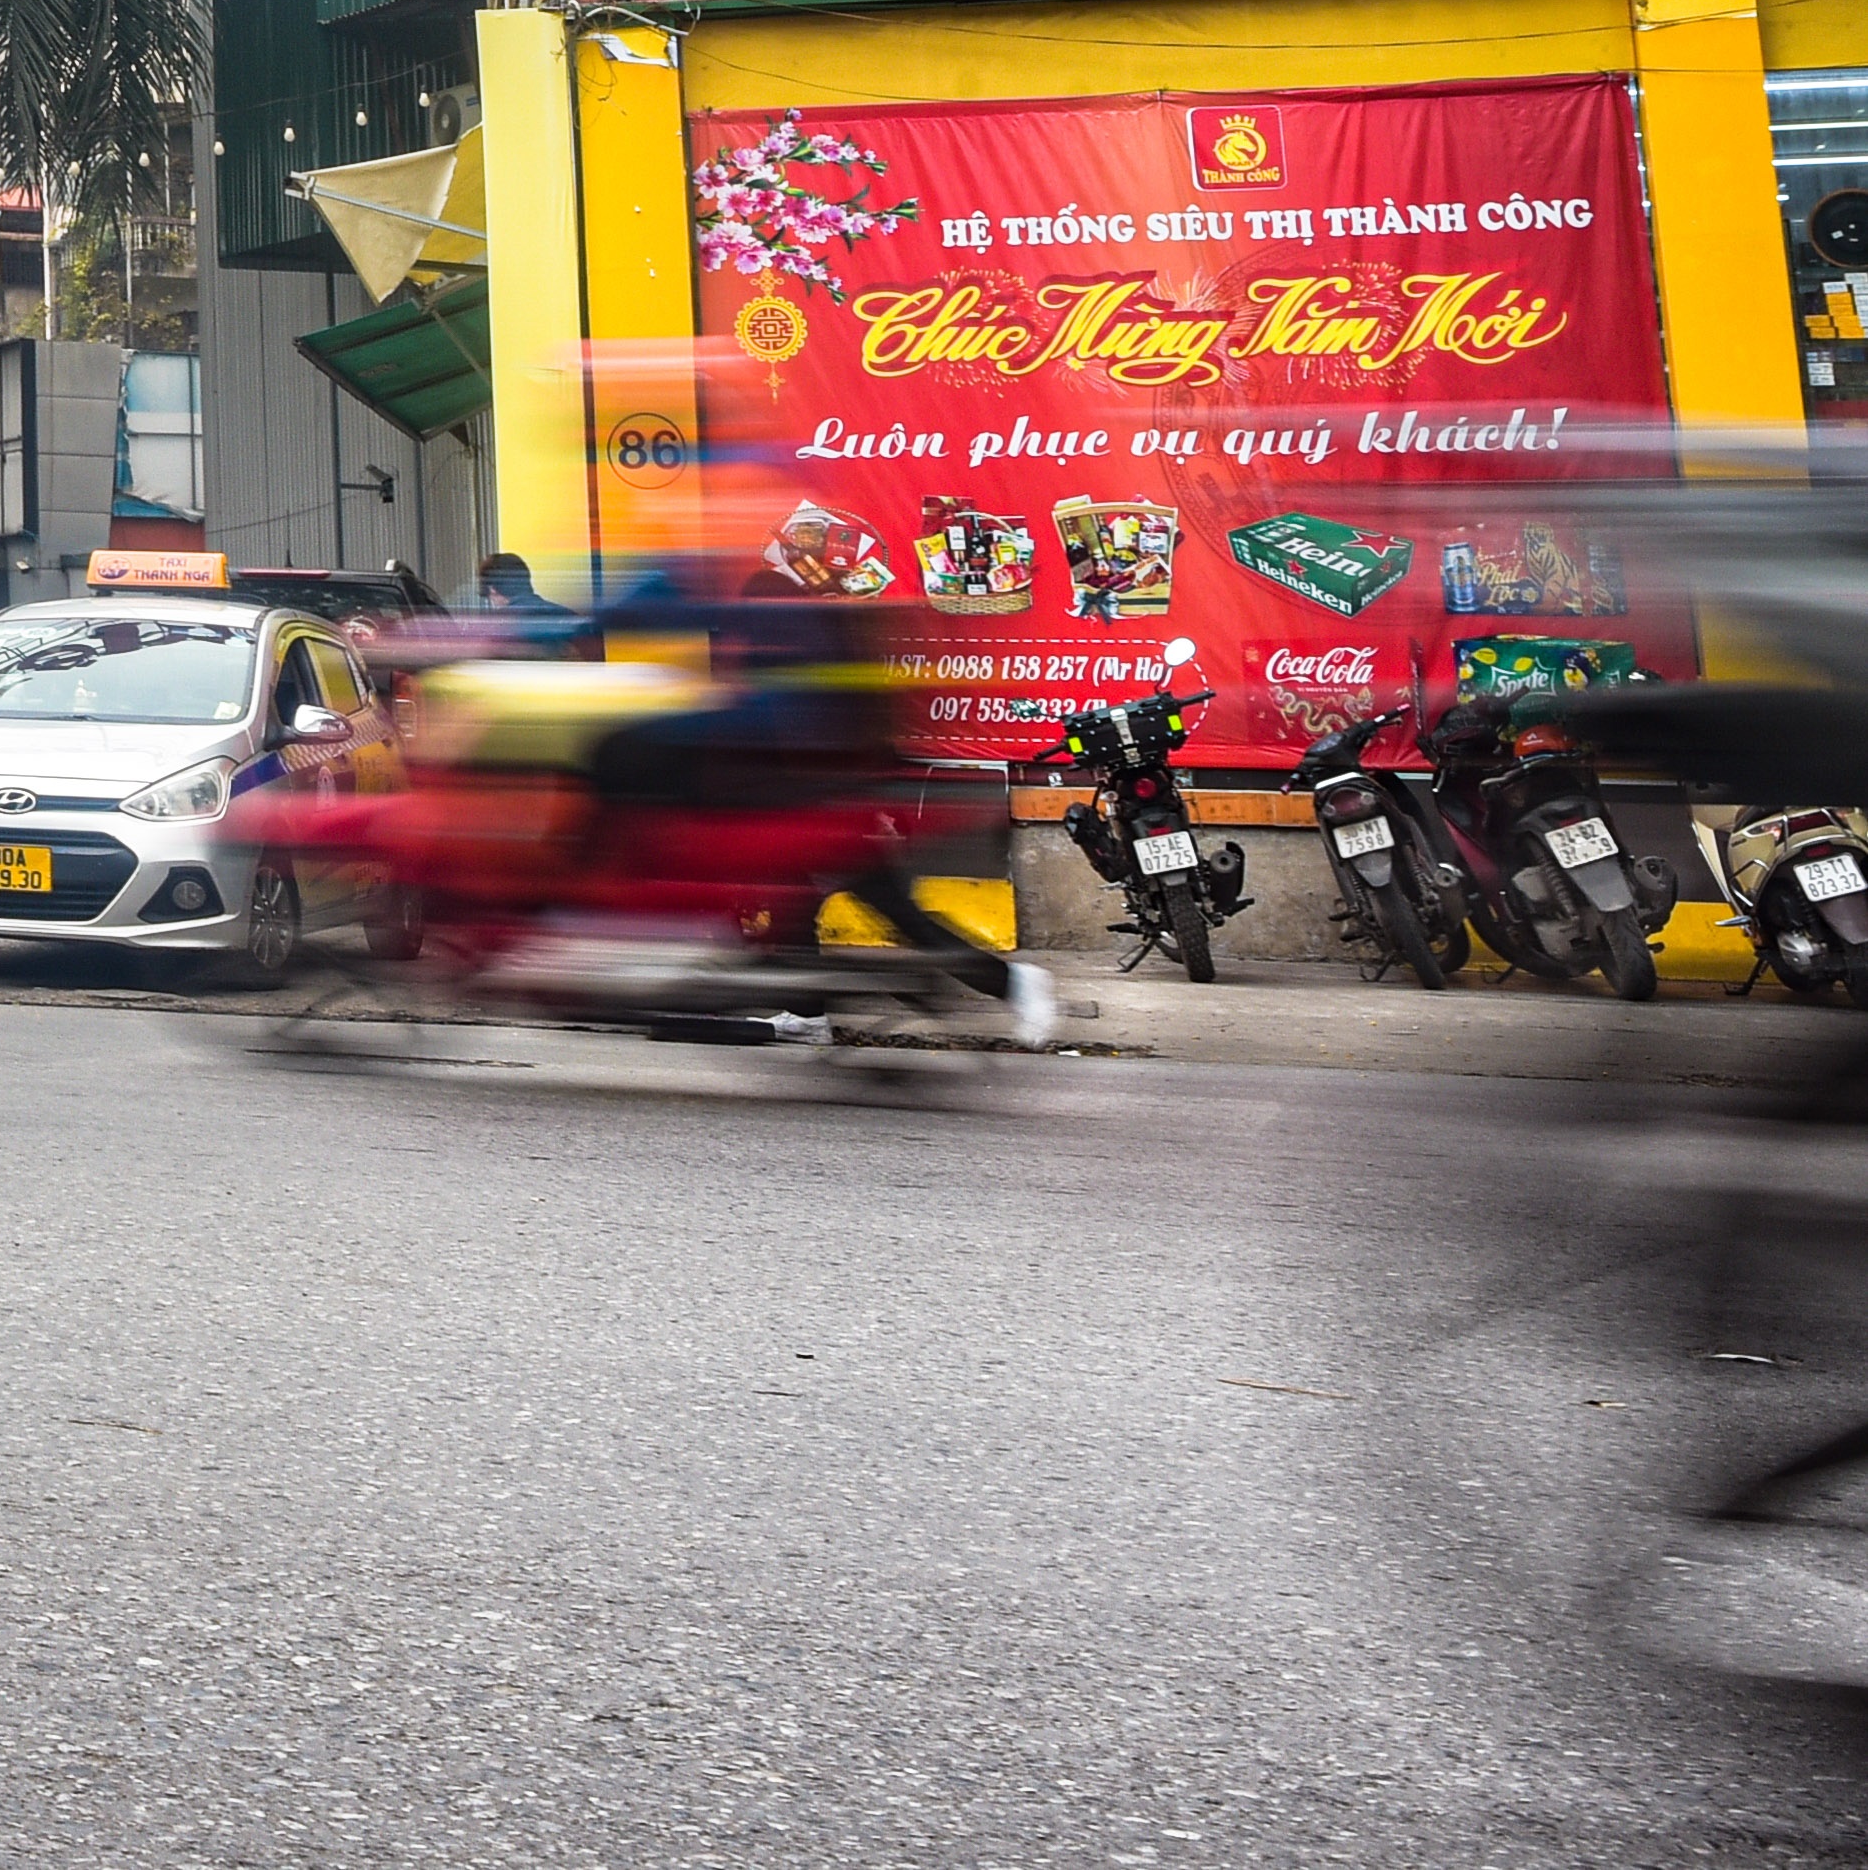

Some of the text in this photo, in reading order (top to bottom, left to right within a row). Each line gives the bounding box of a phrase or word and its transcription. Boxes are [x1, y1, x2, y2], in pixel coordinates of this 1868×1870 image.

[1202, 166, 1281, 184] THÀNH CÔNG
[940, 192, 1594, 255] HỆ THỐNG SIÊU THỊ THÀNH CÔNG
[852, 271, 1568, 388] Chúc Mừng Năm Mới
[618, 429, 682, 470] 86
[795, 407, 1568, 468] Luôn phục vụ quý khách!
[159, 557, 187, 567] TAXI
[134, 569, 178, 581] THANH
[182, 571, 210, 581] NGA
[1255, 557, 1353, 615] Heineken
[936, 654, 994, 680] 0988
[1001, 655, 1041, 681] 158
[1044, 656, 1089, 681] 257
[1093, 656, 1132, 687] (Mr
[1265, 647, 1379, 684] Coca-Cola
[1495, 665, 1550, 698] Sprite
[930, 696, 970, 721] 097
[1146, 836, 1183, 855] 15-AE
[1345, 834, 1385, 854] 7598
[1144, 849, 1193, 871] 072.25
[1805, 858, 1847, 880] 29-T1
[1808, 873, 1861, 897] 823.32
